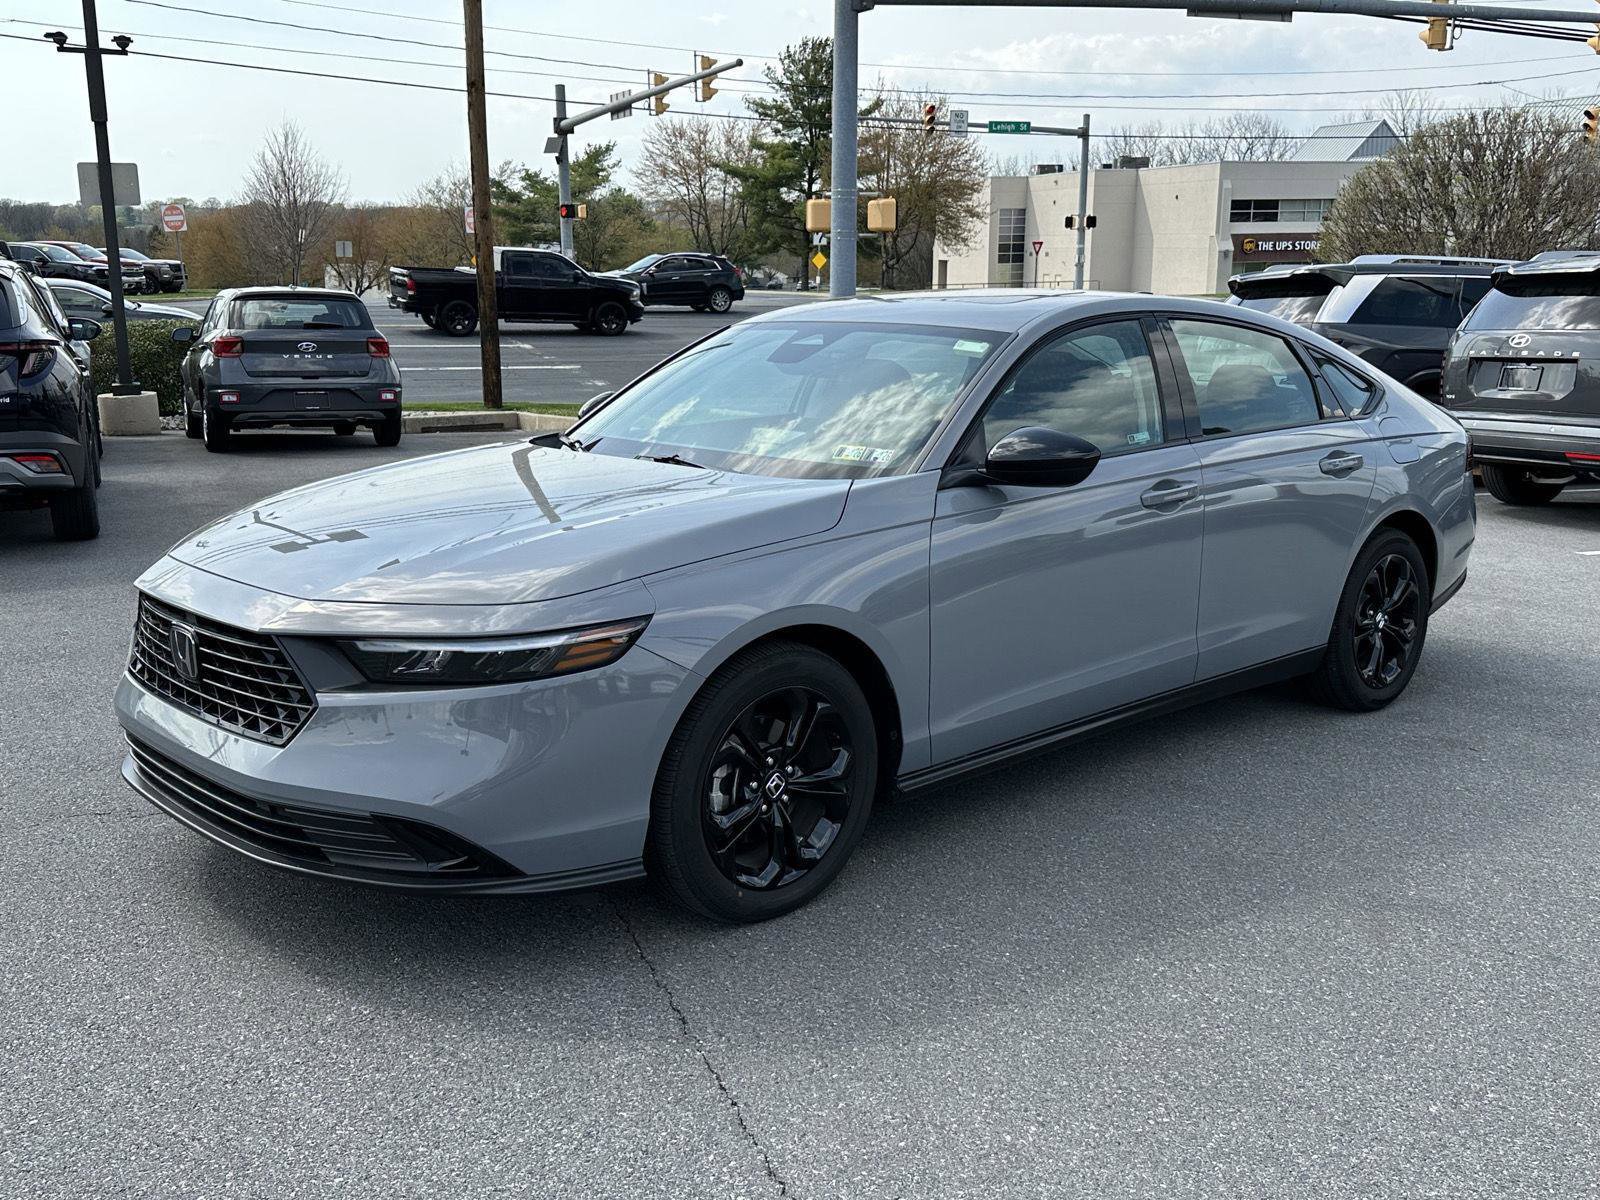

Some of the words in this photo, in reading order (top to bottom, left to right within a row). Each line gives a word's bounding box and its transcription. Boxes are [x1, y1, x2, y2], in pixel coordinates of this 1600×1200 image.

[992, 123, 1016, 132] Lehigh
[1019, 123, 1027, 131] St
[1258, 241, 1274, 251] THE
[1276, 241, 1293, 251] UPS
